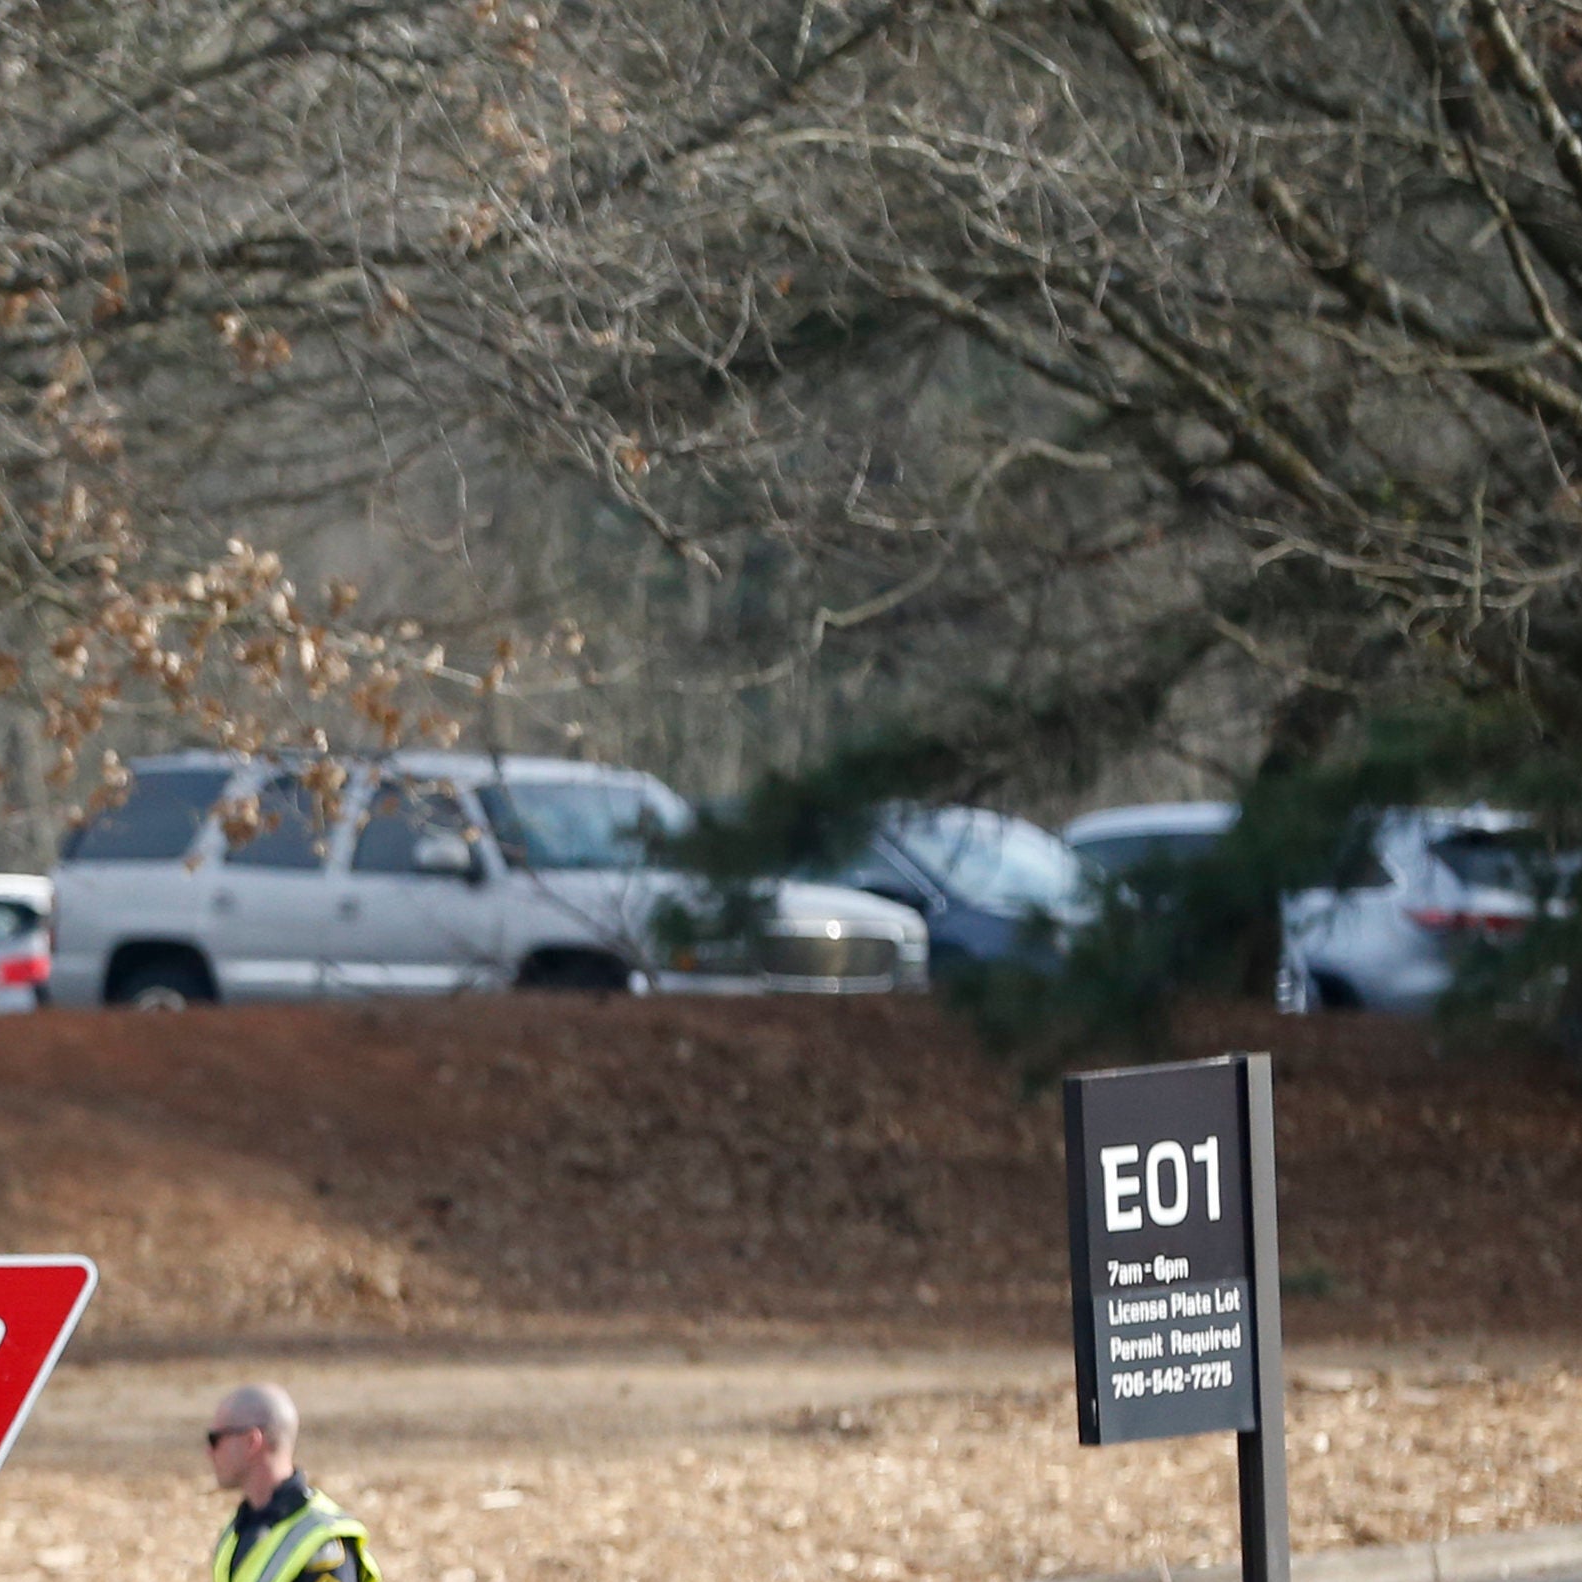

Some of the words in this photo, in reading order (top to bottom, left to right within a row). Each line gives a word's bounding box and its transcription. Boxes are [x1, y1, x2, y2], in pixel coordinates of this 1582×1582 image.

[1100, 1136, 1221, 1232] E01
[1108, 1299, 1167, 1326] License
[1171, 1292, 1211, 1318] Plate
[1215, 1288, 1240, 1313] Lot
[1110, 1332, 1164, 1362] Permit
[1170, 1322, 1241, 1357] Required
